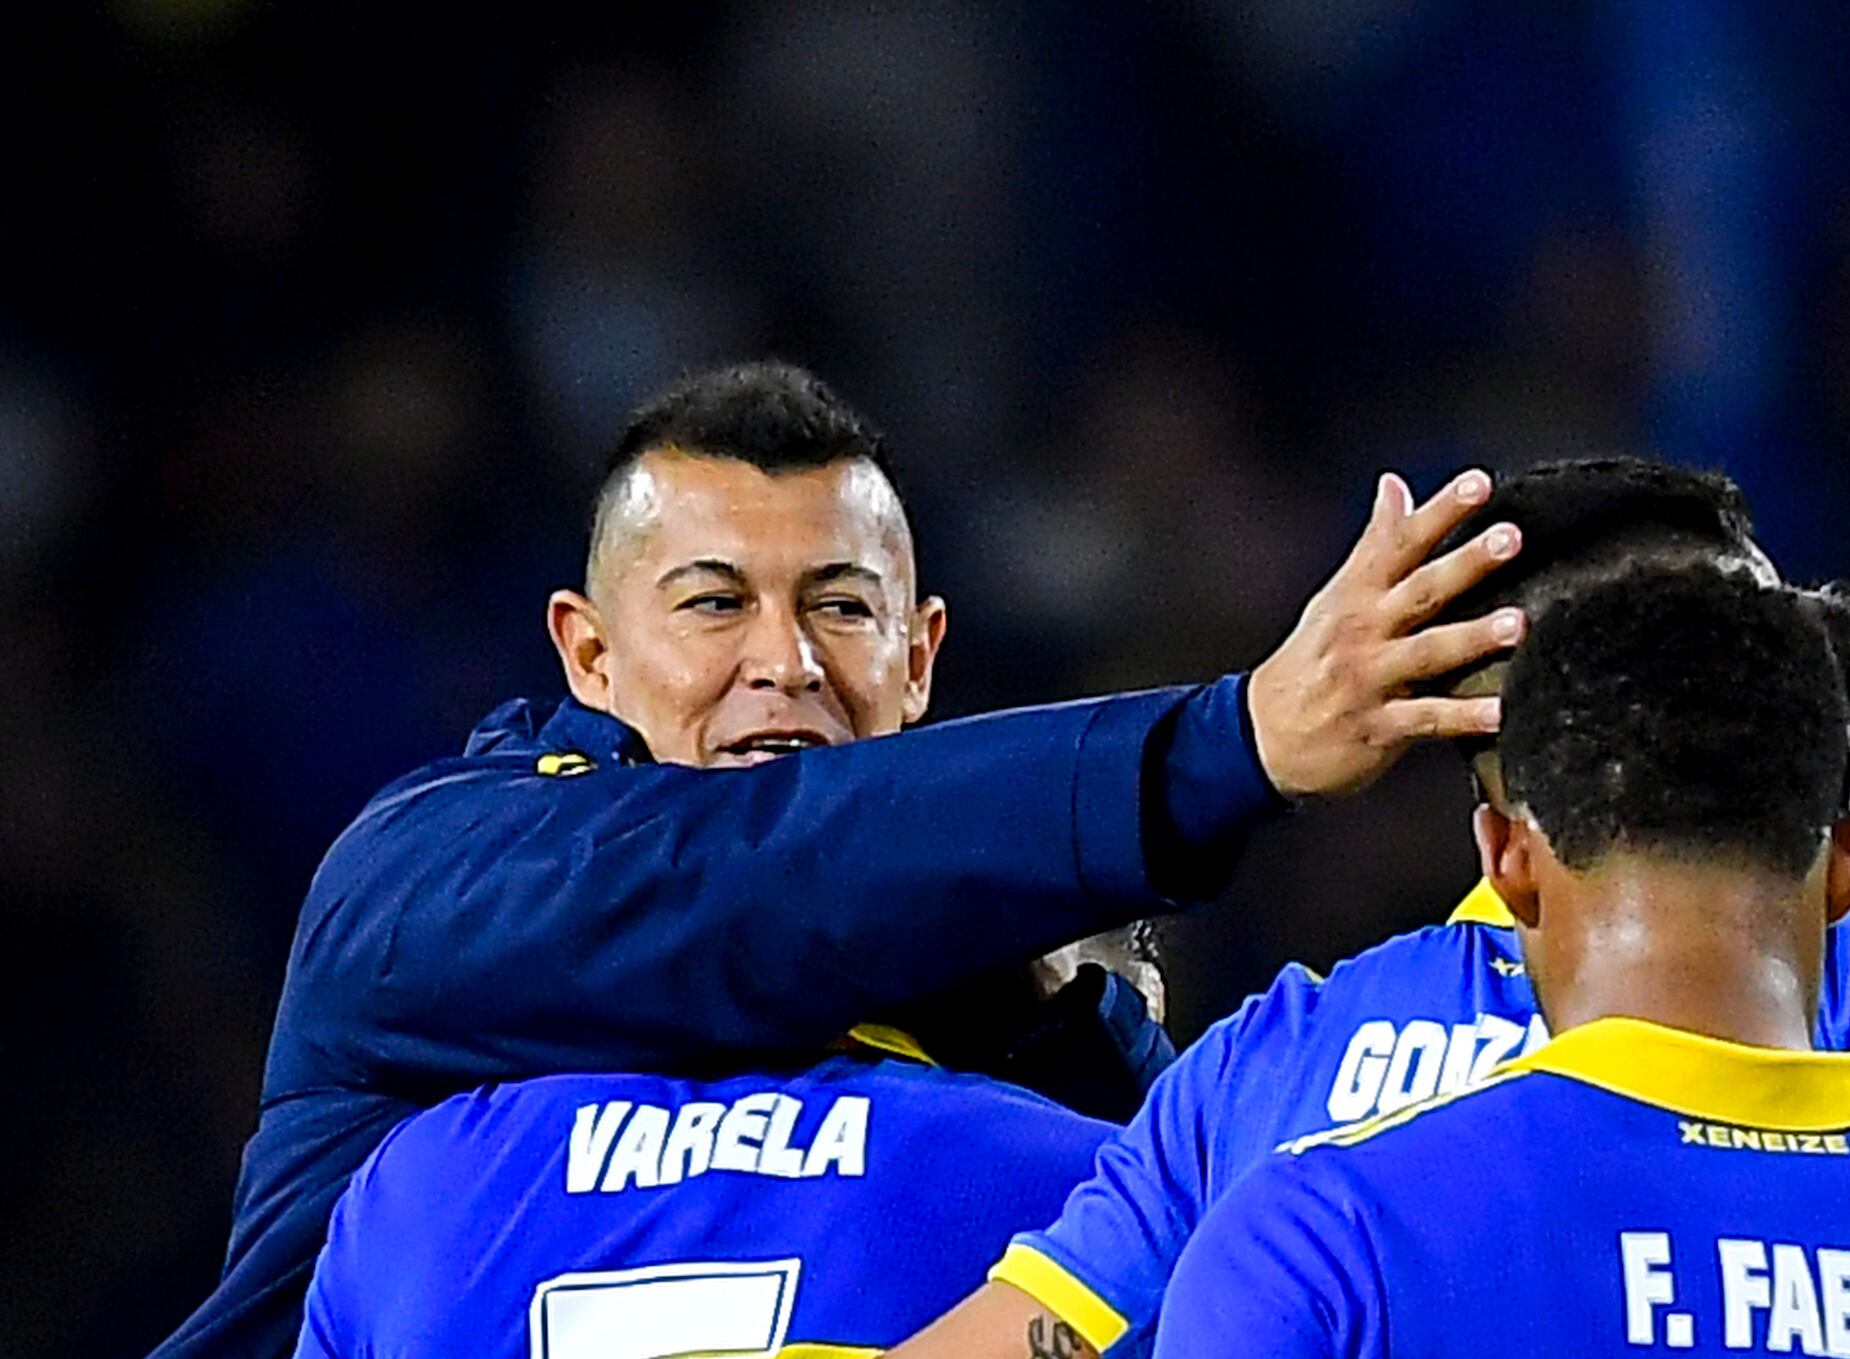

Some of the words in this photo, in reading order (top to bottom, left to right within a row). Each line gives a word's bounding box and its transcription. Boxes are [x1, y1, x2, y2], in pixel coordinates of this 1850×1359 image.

[566, 1093, 871, 1193] VARELA
[1678, 1121, 1850, 1155] XENEIZE
[1620, 1231, 1694, 1346] F.
